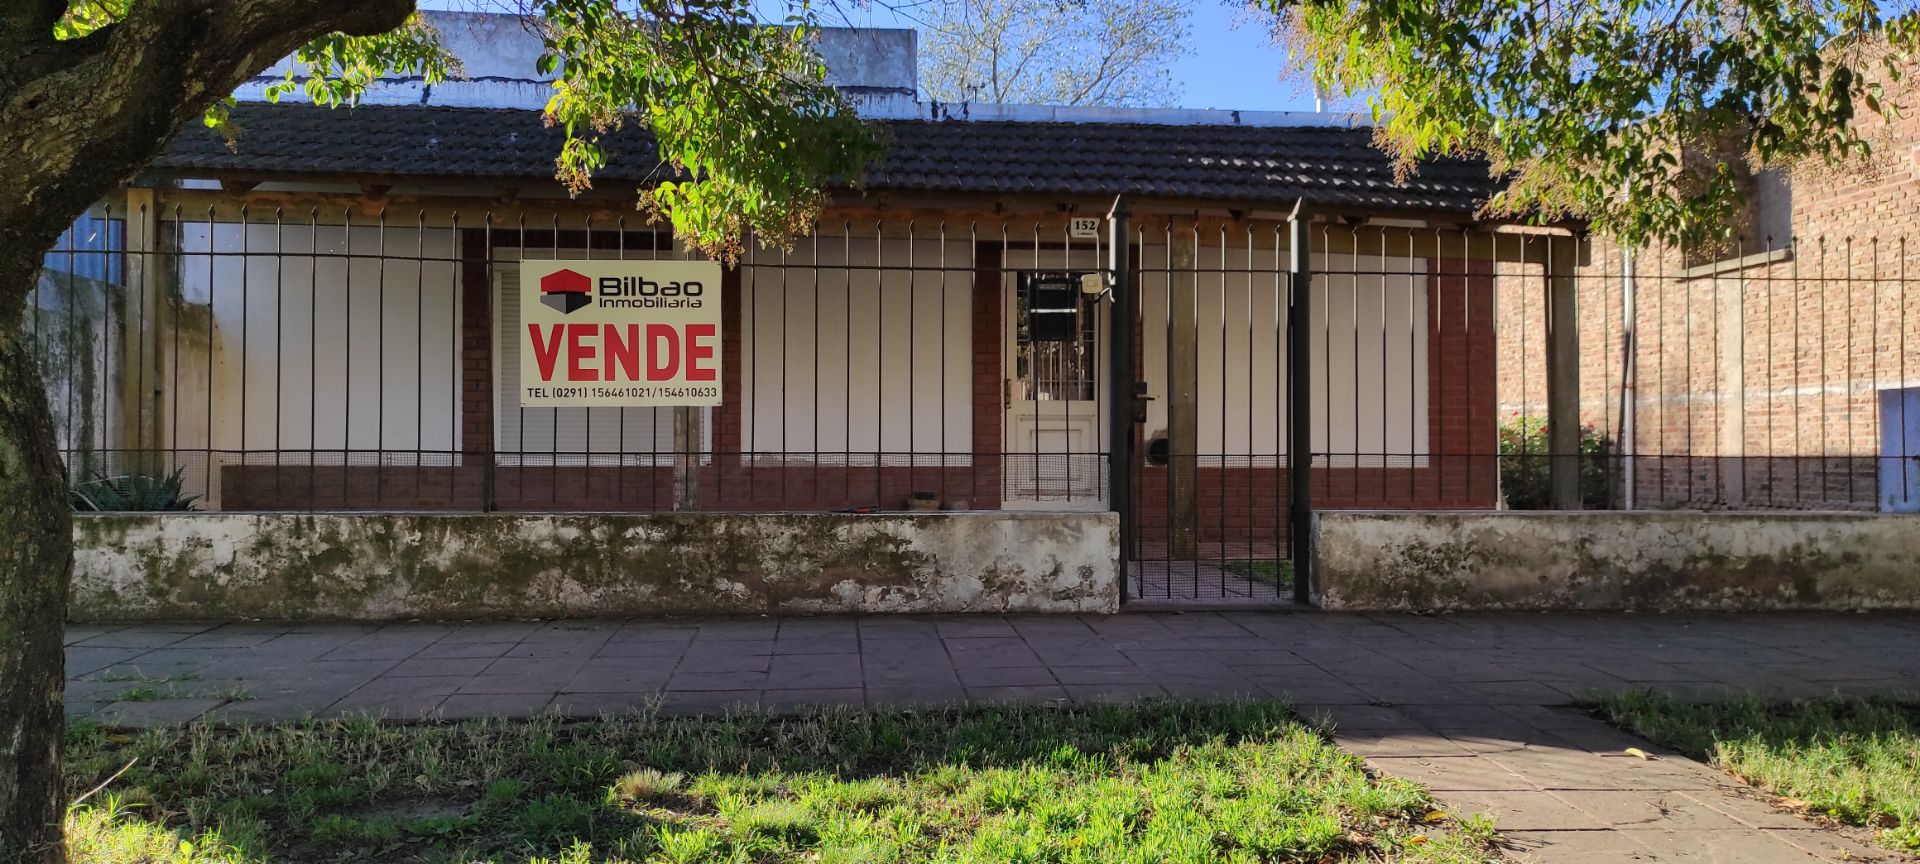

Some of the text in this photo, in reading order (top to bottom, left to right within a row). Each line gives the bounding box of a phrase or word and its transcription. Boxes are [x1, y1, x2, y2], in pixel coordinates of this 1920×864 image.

[1075, 220, 1096, 231] 152
[599, 277, 703, 297] Bilbao
[599, 297, 703, 308] Inmobiliaria
[528, 323, 717, 381] VENDE
[527, 387, 717, 398] TEL (0291) 156461021/154610633
